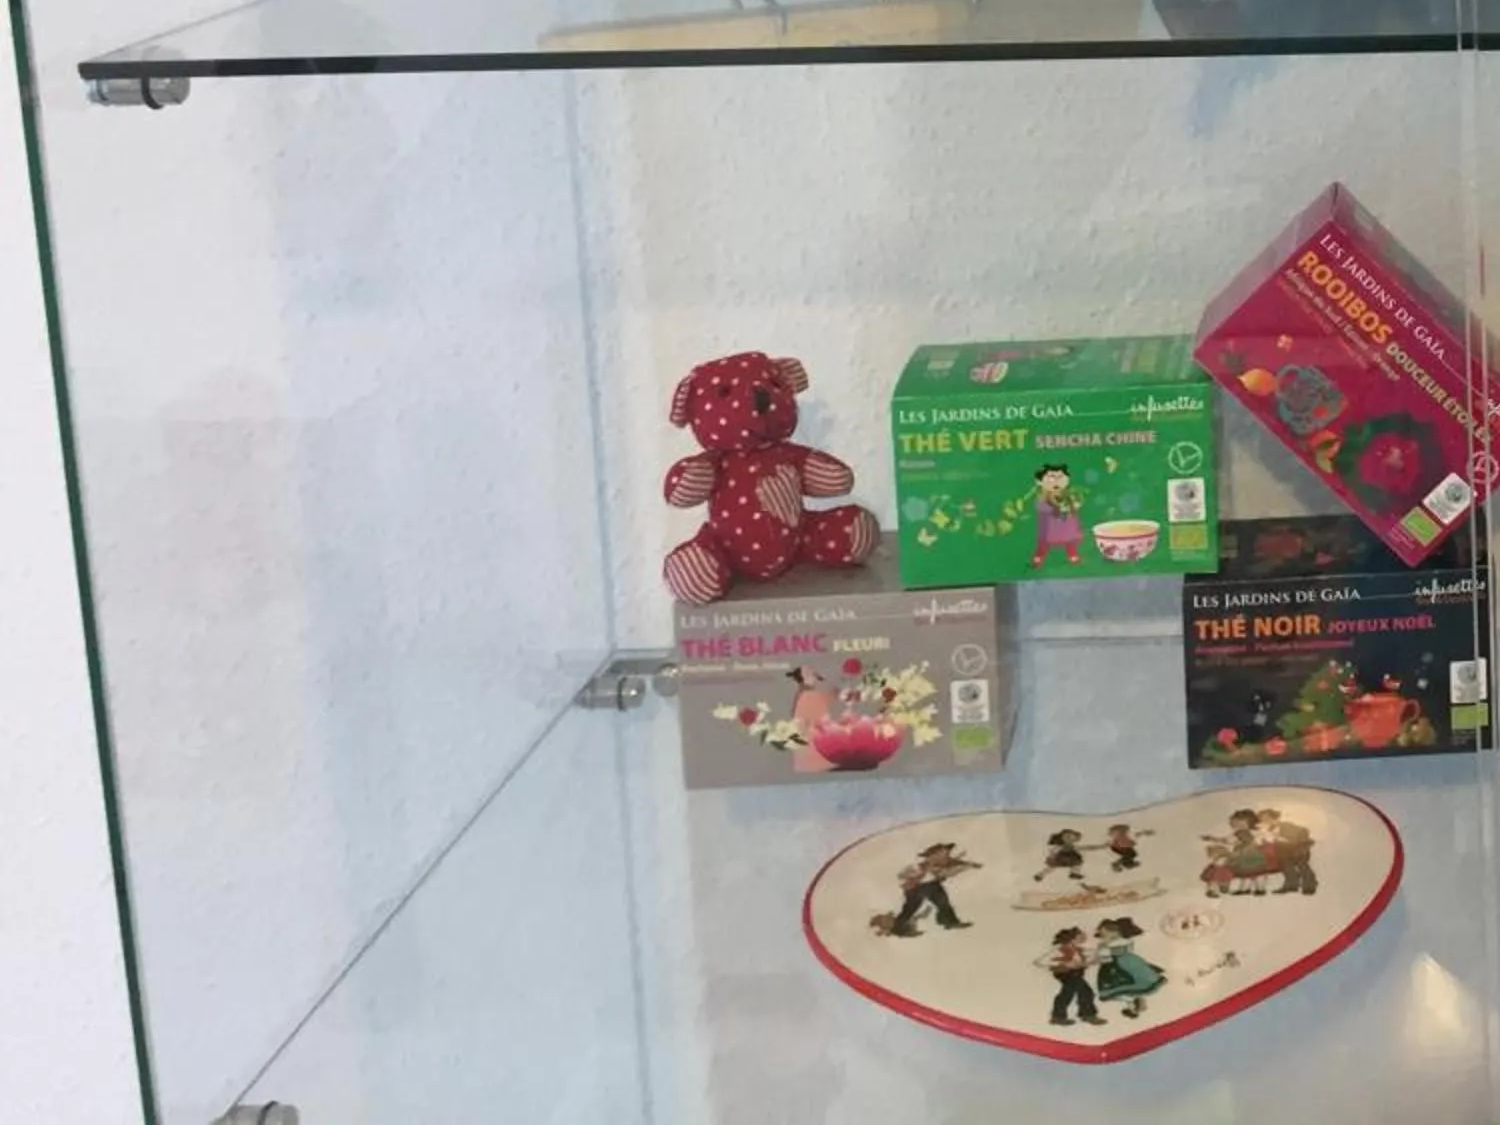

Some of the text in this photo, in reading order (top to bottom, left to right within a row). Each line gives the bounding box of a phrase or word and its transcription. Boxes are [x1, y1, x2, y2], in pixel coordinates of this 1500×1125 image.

[1319, 234, 1345, 260] LES
[1341, 256, 1398, 310] JARDINS
[1394, 307, 1417, 329] DE
[1297, 250, 1394, 344] ROOIBOS
[1386, 342, 1448, 404] DOUCEUR
[899, 410, 927, 424] LES
[930, 407, 1001, 424] JARDINS
[1005, 405, 1028, 420] DE
[899, 427, 1159, 454] THÉ VERT SENCHA CHINE
[1193, 593, 1219, 608] LES
[1225, 590, 1290, 610] JARDINS
[1295, 589, 1317, 603] DE
[1193, 612, 1248, 640] THÉ
[1253, 613, 1322, 638] NOIR
[1328, 617, 1390, 634] JOYEUX
[738, 632, 829, 658] BLANC
